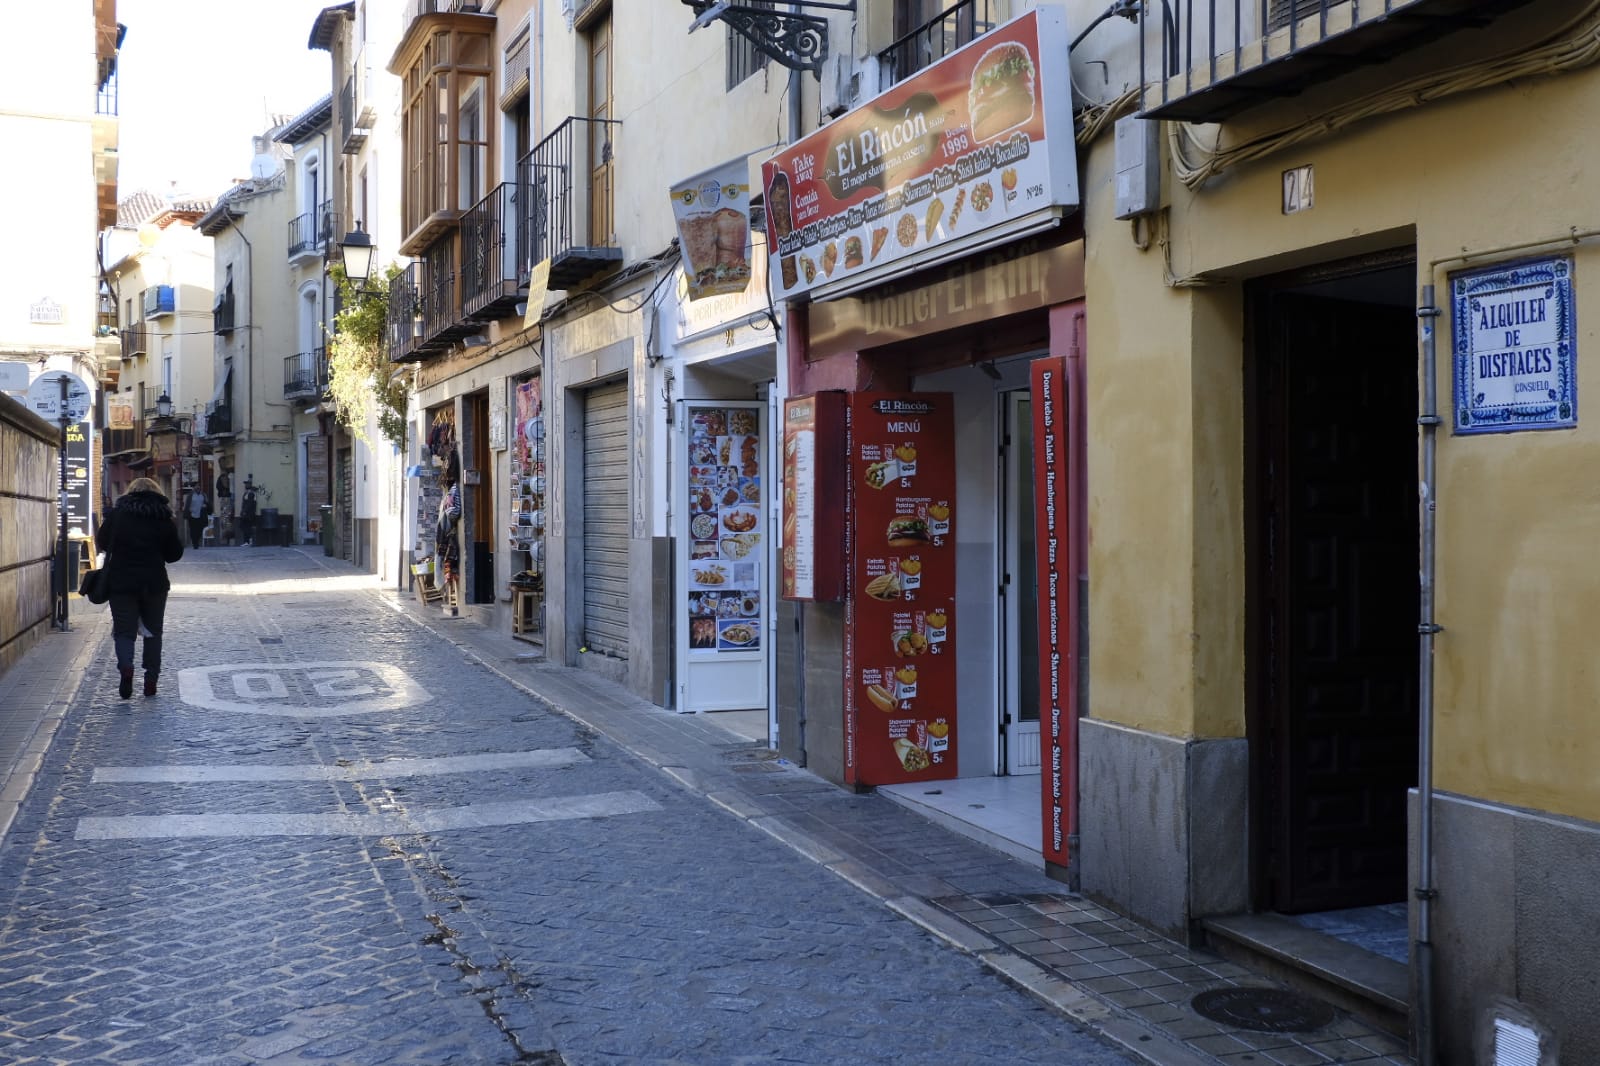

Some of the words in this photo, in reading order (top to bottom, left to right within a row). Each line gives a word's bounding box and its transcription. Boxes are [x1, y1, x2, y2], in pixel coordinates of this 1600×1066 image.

[836, 138, 857, 177] El
[859, 108, 928, 166] Rincón
[941, 134, 969, 158] 1999
[995, 138, 1029, 164] Bocadillos
[792, 153, 815, 175] Take
[795, 167, 814, 185] away
[841, 175, 851, 191] El
[1286, 165, 1313, 212] 24
[795, 189, 819, 209] Comida
[1479, 297, 1547, 331] ALQUILER
[1504, 330, 1521, 348] DE
[1479, 348, 1552, 380] DISFRACES
[1042, 372, 1051, 398] Donar
[1514, 379, 1550, 394] CONSUELO
[880, 400, 892, 410] El
[893, 399, 928, 410] Rincón
[1044, 399, 1052, 426] kebab
[887, 418, 921, 433] MENÚ
[1045, 434, 1054, 463] Falafel
[1046, 471, 1055, 529] Hamburguesa
[1049, 538, 1057, 563] Pizza
[1049, 572, 1058, 598] Tacos
[1050, 599, 1058, 644] mexicanos
[1051, 653, 1059, 699] Shawarma
[1052, 746, 1061, 771] Shish
[1053, 772, 1061, 798] kebab
[1053, 806, 1062, 851] Bocadillos
